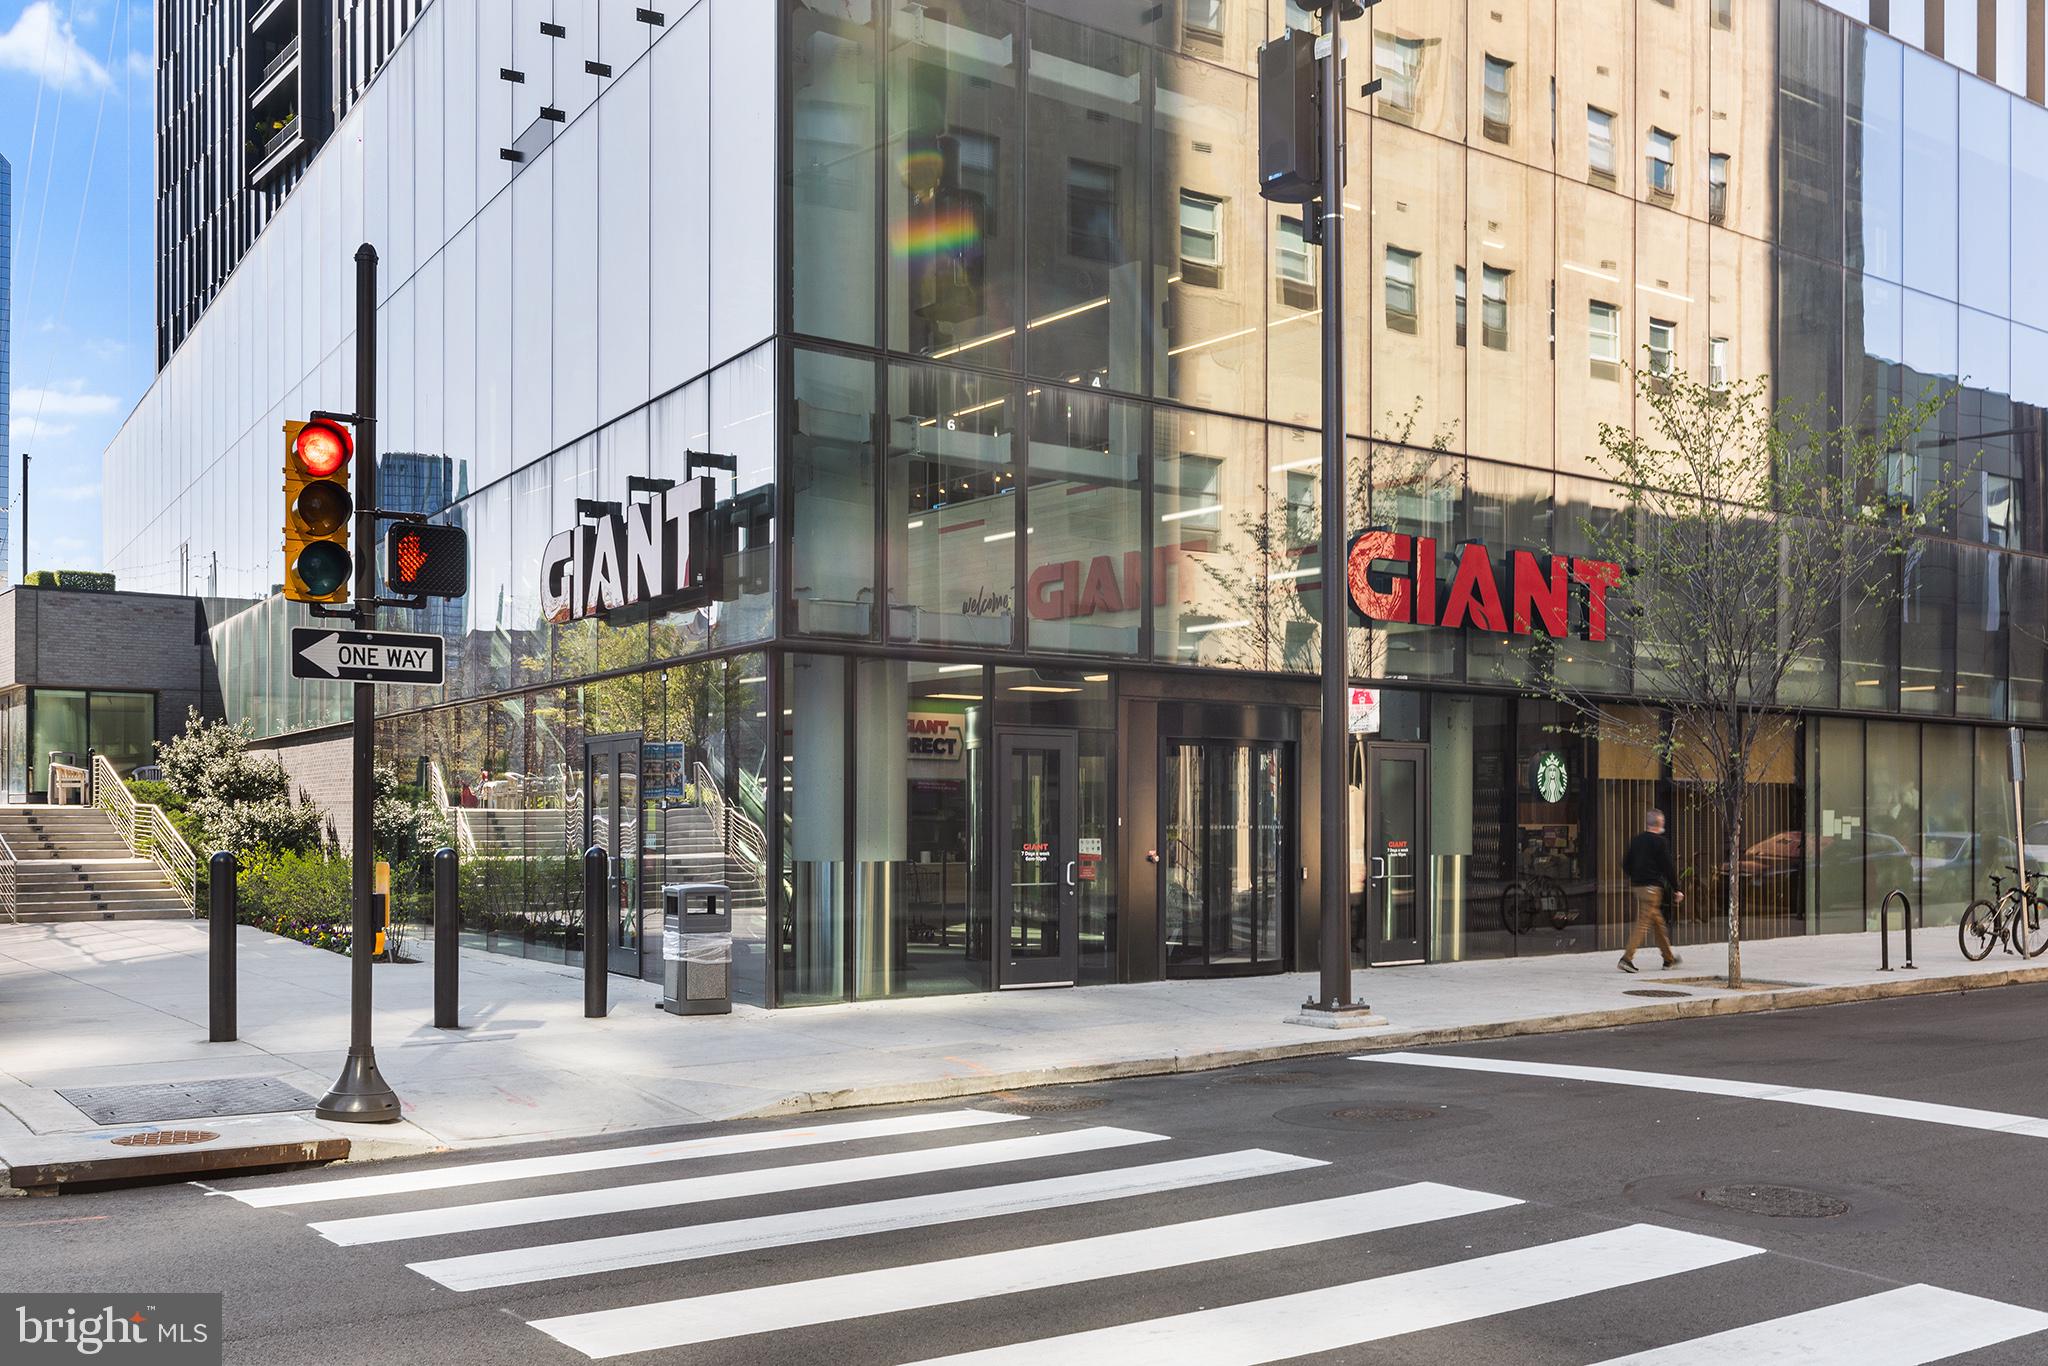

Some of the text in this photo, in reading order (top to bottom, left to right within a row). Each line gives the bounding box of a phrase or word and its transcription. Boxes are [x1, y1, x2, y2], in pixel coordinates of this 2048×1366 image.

[1092, 377, 1101, 388] 4
[946, 419, 956, 431] 6
[540, 476, 706, 624] GIANT
[1027, 539, 1208, 620] GIANT
[1348, 528, 1620, 641] GIANT
[338, 645, 428, 669] ONE WAY
[909, 737, 957, 755] RECT
